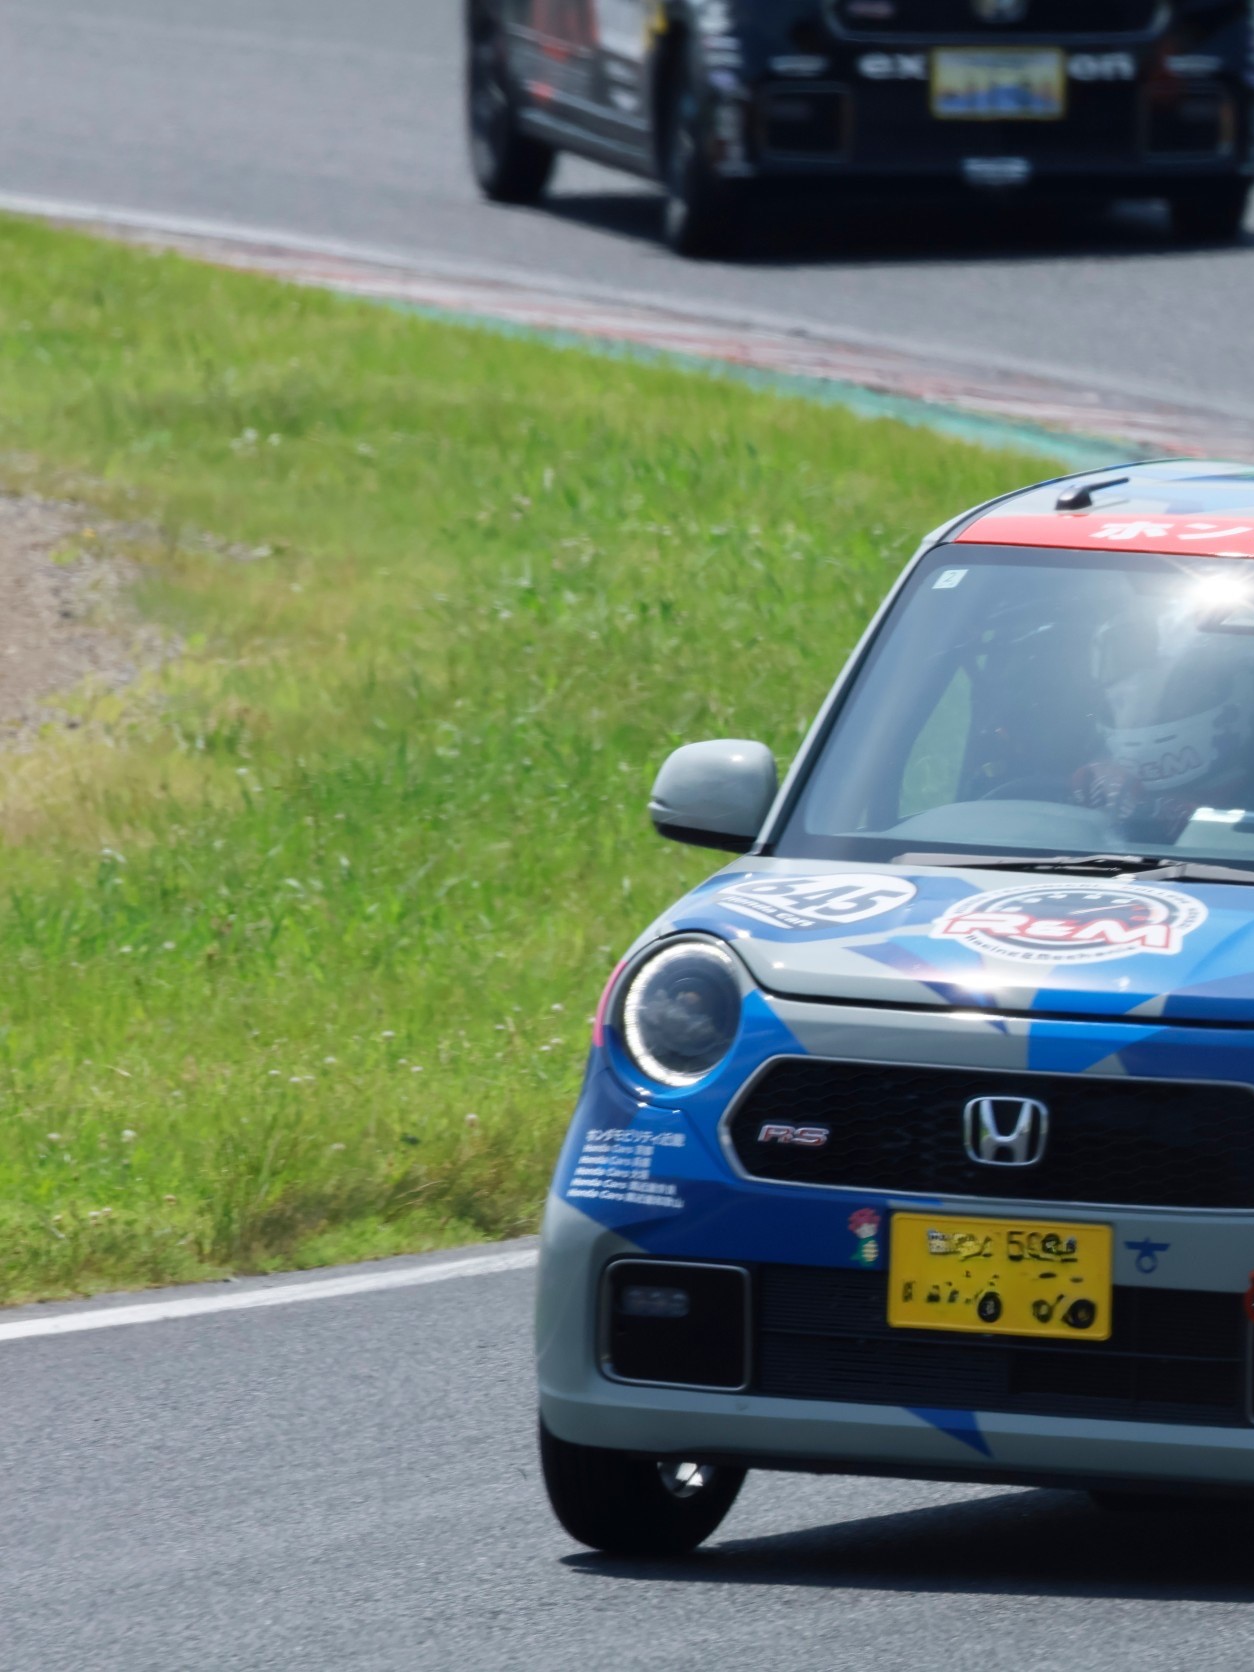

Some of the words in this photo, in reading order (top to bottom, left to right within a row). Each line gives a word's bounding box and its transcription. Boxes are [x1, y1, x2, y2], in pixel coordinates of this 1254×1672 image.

[734, 879, 910, 917] 645
[775, 912, 816, 927] Cars
[757, 1123, 830, 1146] RS
